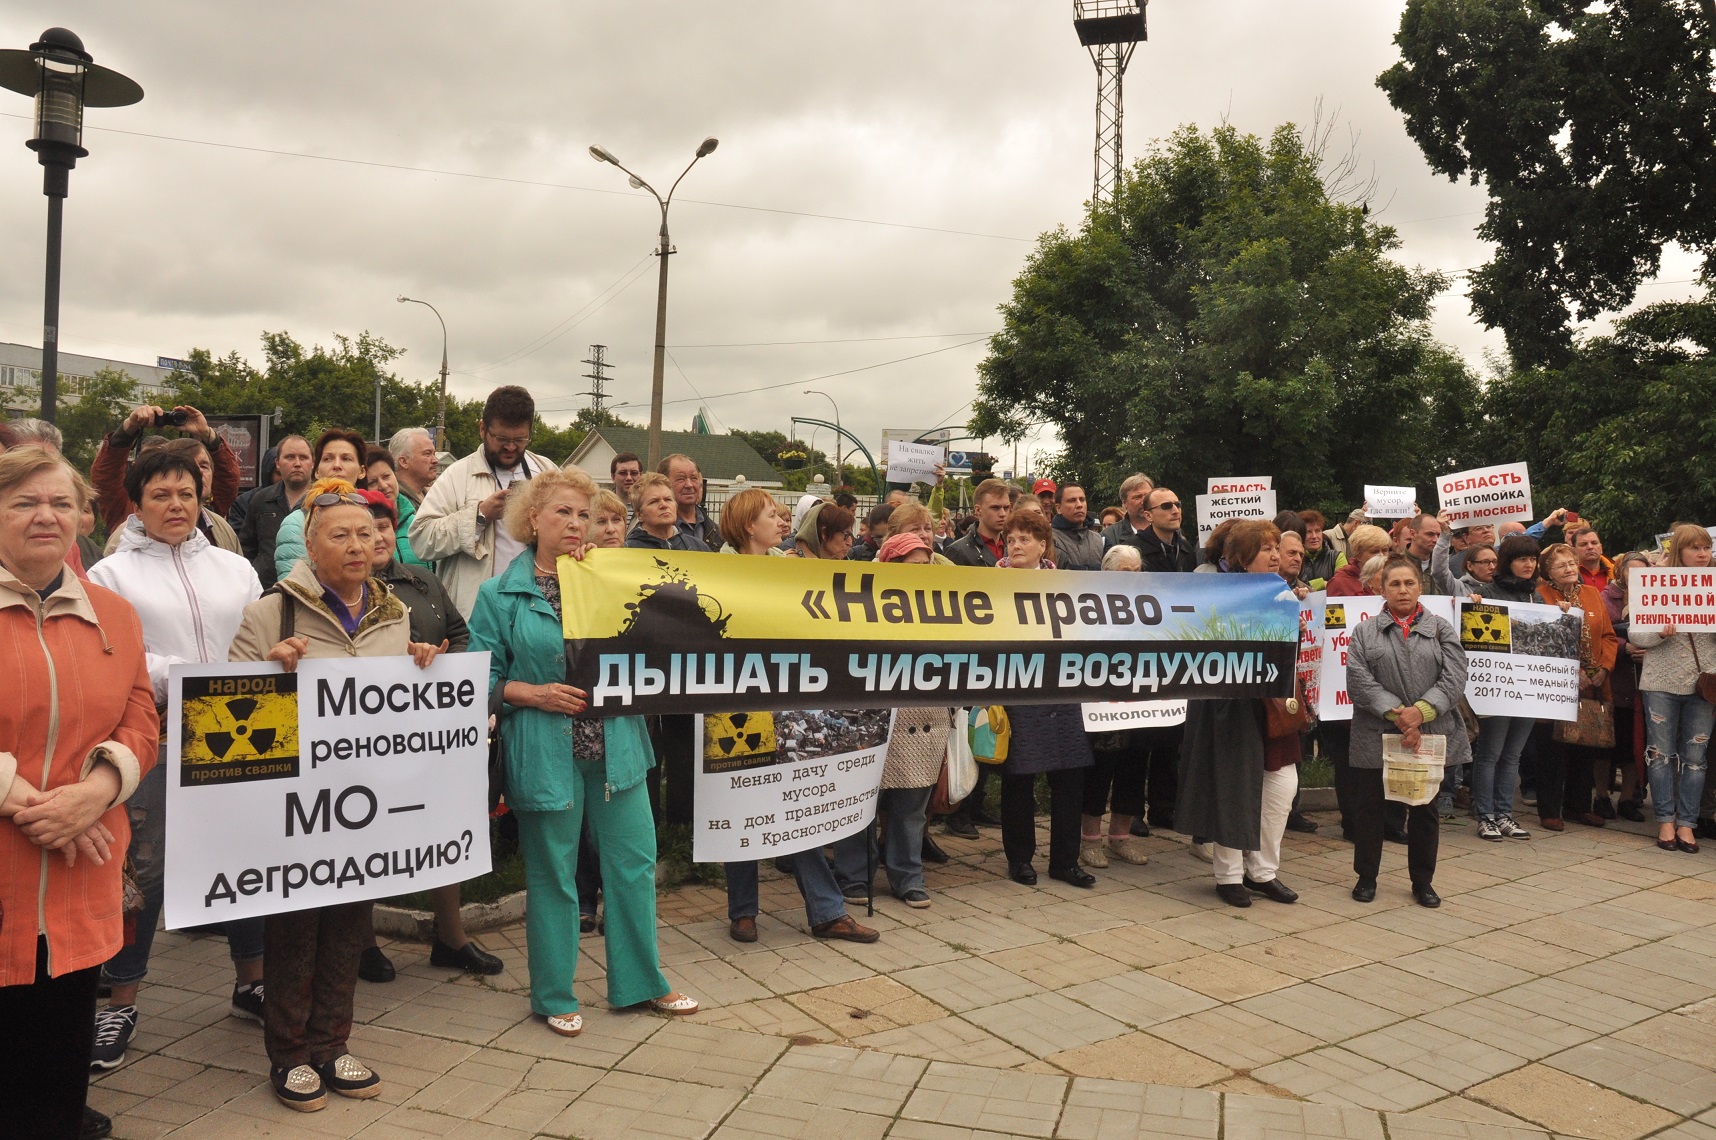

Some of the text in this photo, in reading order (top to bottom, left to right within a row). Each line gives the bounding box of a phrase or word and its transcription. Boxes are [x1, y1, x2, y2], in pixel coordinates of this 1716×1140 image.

[899, 445, 909, 453] На
[907, 456, 926, 465] жить
[1442, 472, 1522, 494] ОБЛАСТЬ
[1374, 488, 1406, 496] Верните
[1444, 490, 1524, 507] НЕ ПОМОЙКА
[1211, 495, 1261, 506] ЖЁСТКИЙ
[1210, 508, 1264, 518] КОНТРОЛЬ
[1474, 504, 1527, 518] МОСКВЫ
[1200, 524, 1212, 532] ЗА
[1641, 574, 1713, 587] ТРЕБУЕМ
[801, 572, 994, 625] «Наше
[1014, 592, 1163, 639] право
[1642, 592, 1715, 606] СРОЧНОЙ
[1472, 603, 1501, 614] народ
[1494, 661, 1512, 671] год
[1527, 663, 1569, 675] хлебный
[208, 676, 276, 695] народ
[592, 652, 1279, 707] ДЫШАТЬ ЧИСТЫМ ВОЗДУХОМ!»
[1495, 675, 1514, 685] год
[1530, 678, 1569, 688] медный
[316, 677, 475, 717] Москве
[1474, 687, 1501, 697] 2017
[1504, 690, 1522, 700] год
[311, 726, 479, 769] реновацию
[710, 755, 771, 770] против свалки
[191, 762, 292, 780] против свалки
[730, 754, 876, 789] Меняю дачу среди
[782, 782, 836, 804] мусора
[285, 785, 378, 837] МО
[708, 786, 879, 830] на дом правительства
[740, 809, 863, 847] в Красногорске!
[204, 829, 473, 908] деградацию?
